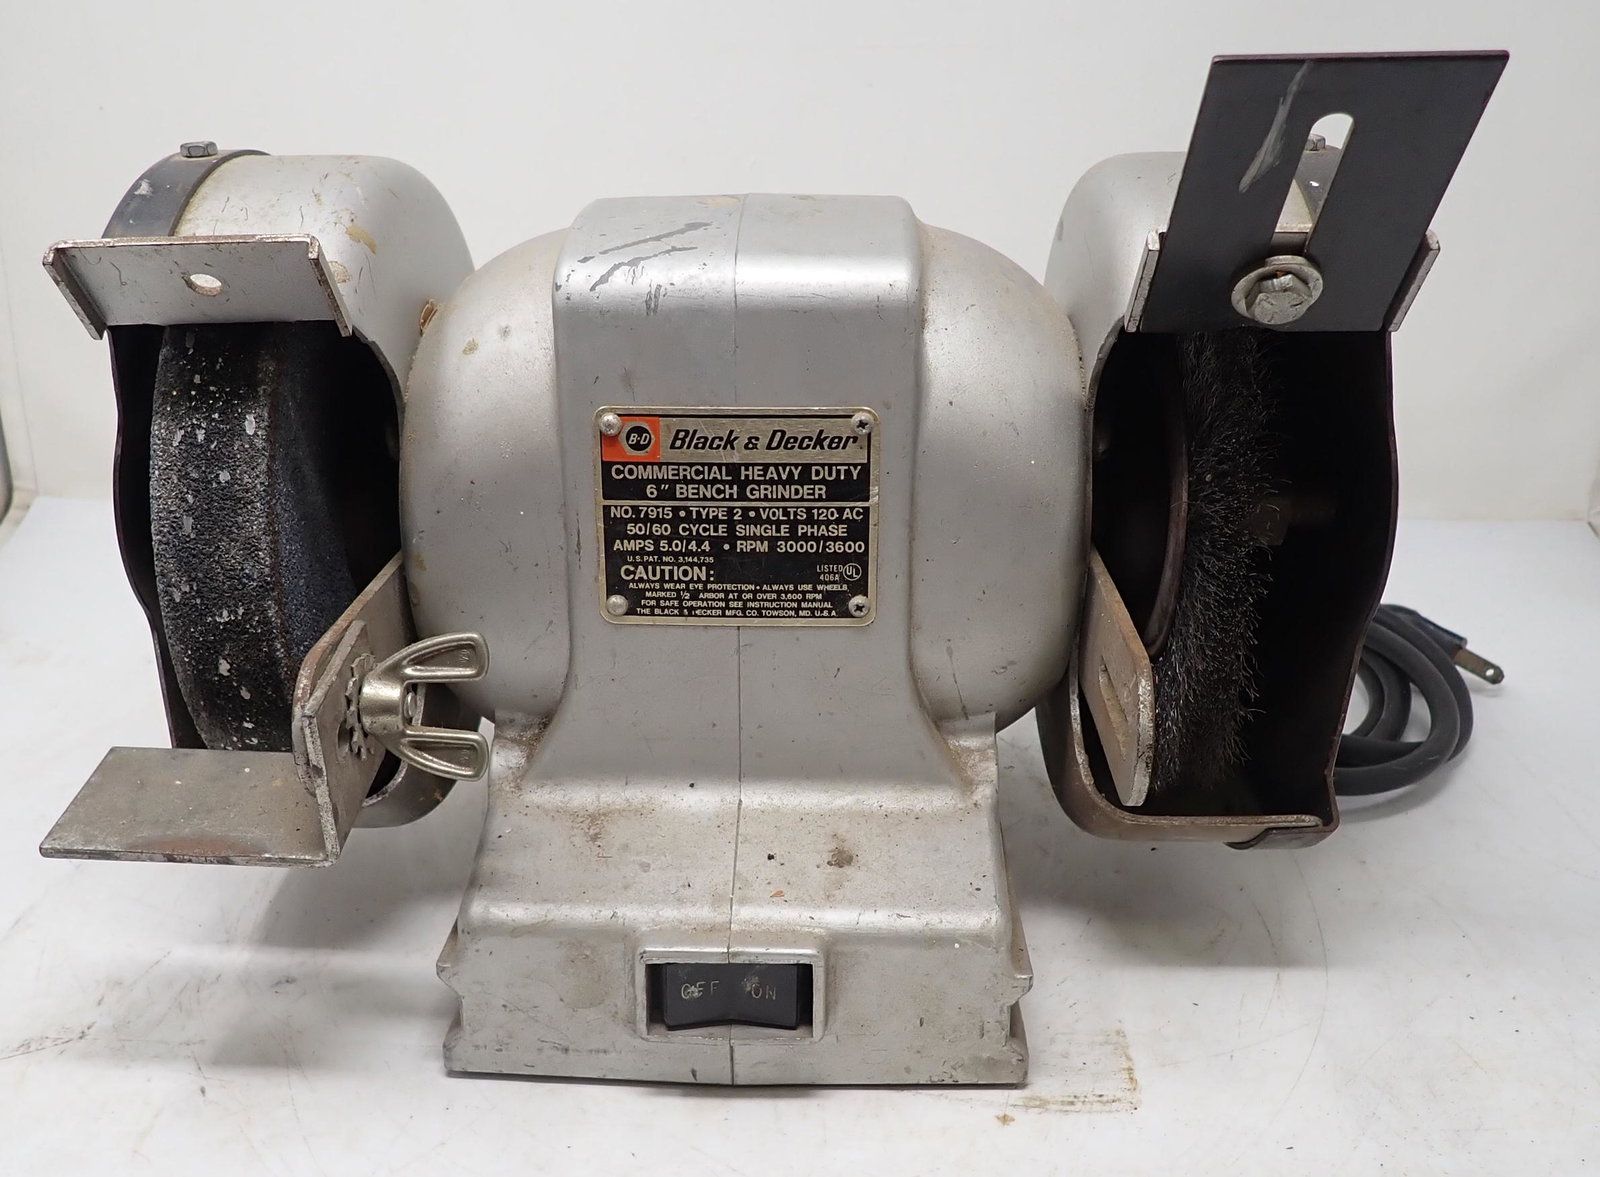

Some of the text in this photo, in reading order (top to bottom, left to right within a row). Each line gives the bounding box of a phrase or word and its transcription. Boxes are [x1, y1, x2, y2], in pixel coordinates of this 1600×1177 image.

[669, 428, 858, 451] Black & Decker
[611, 464, 862, 481] COMMERCIAL HEAVY DUTY
[675, 484, 738, 499] BENCH
[746, 484, 827, 500] GRINDER
[610, 506, 864, 521] NO. 7915 TYPE 2 VOLTS 120 AC
[626, 523, 848, 537] 50/60 CYCLE SINGLE PHASE
[613, 539, 865, 553] AMPS 5.0/4.4 RPM 3000/3600
[678, 556, 714, 564] 3,144,735
[620, 564, 715, 581] CAUTION:
[816, 564, 843, 573] LISTED
[819, 573, 840, 581] 406A
[628, 582, 660, 590] ALWAYS
[707, 583, 755, 591] PROTECTION
[636, 607, 651, 615] THE
[681, 980, 777, 1000] OFF ON
